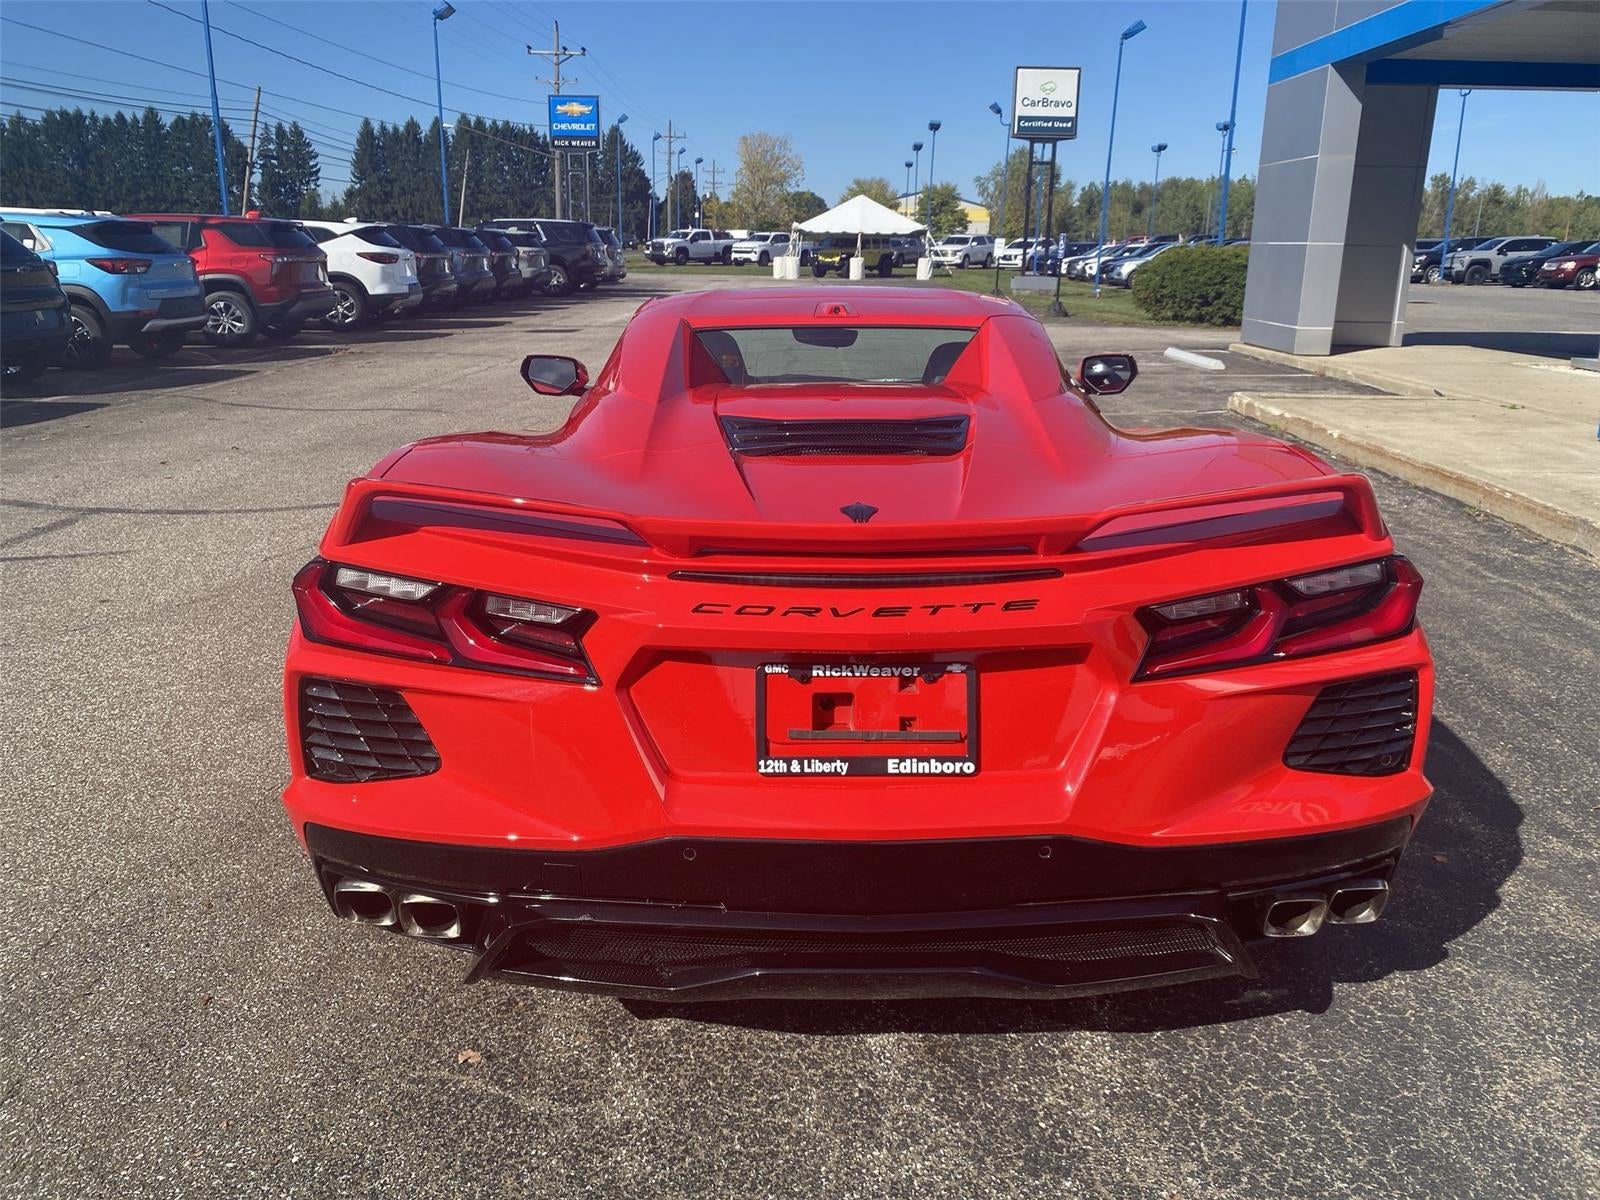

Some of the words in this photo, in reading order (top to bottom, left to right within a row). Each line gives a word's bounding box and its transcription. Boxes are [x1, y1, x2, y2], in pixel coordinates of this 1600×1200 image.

[1021, 97, 1073, 108] CarBravo
[553, 122, 596, 131] CHEVROLET
[691, 599, 1040, 618] CORVETTE
[764, 664, 789, 674] GMC
[758, 760, 787, 773] 12th
[790, 760, 801, 773] &
[804, 760, 849, 775] Liberty
[887, 758, 976, 774] Edinboro
